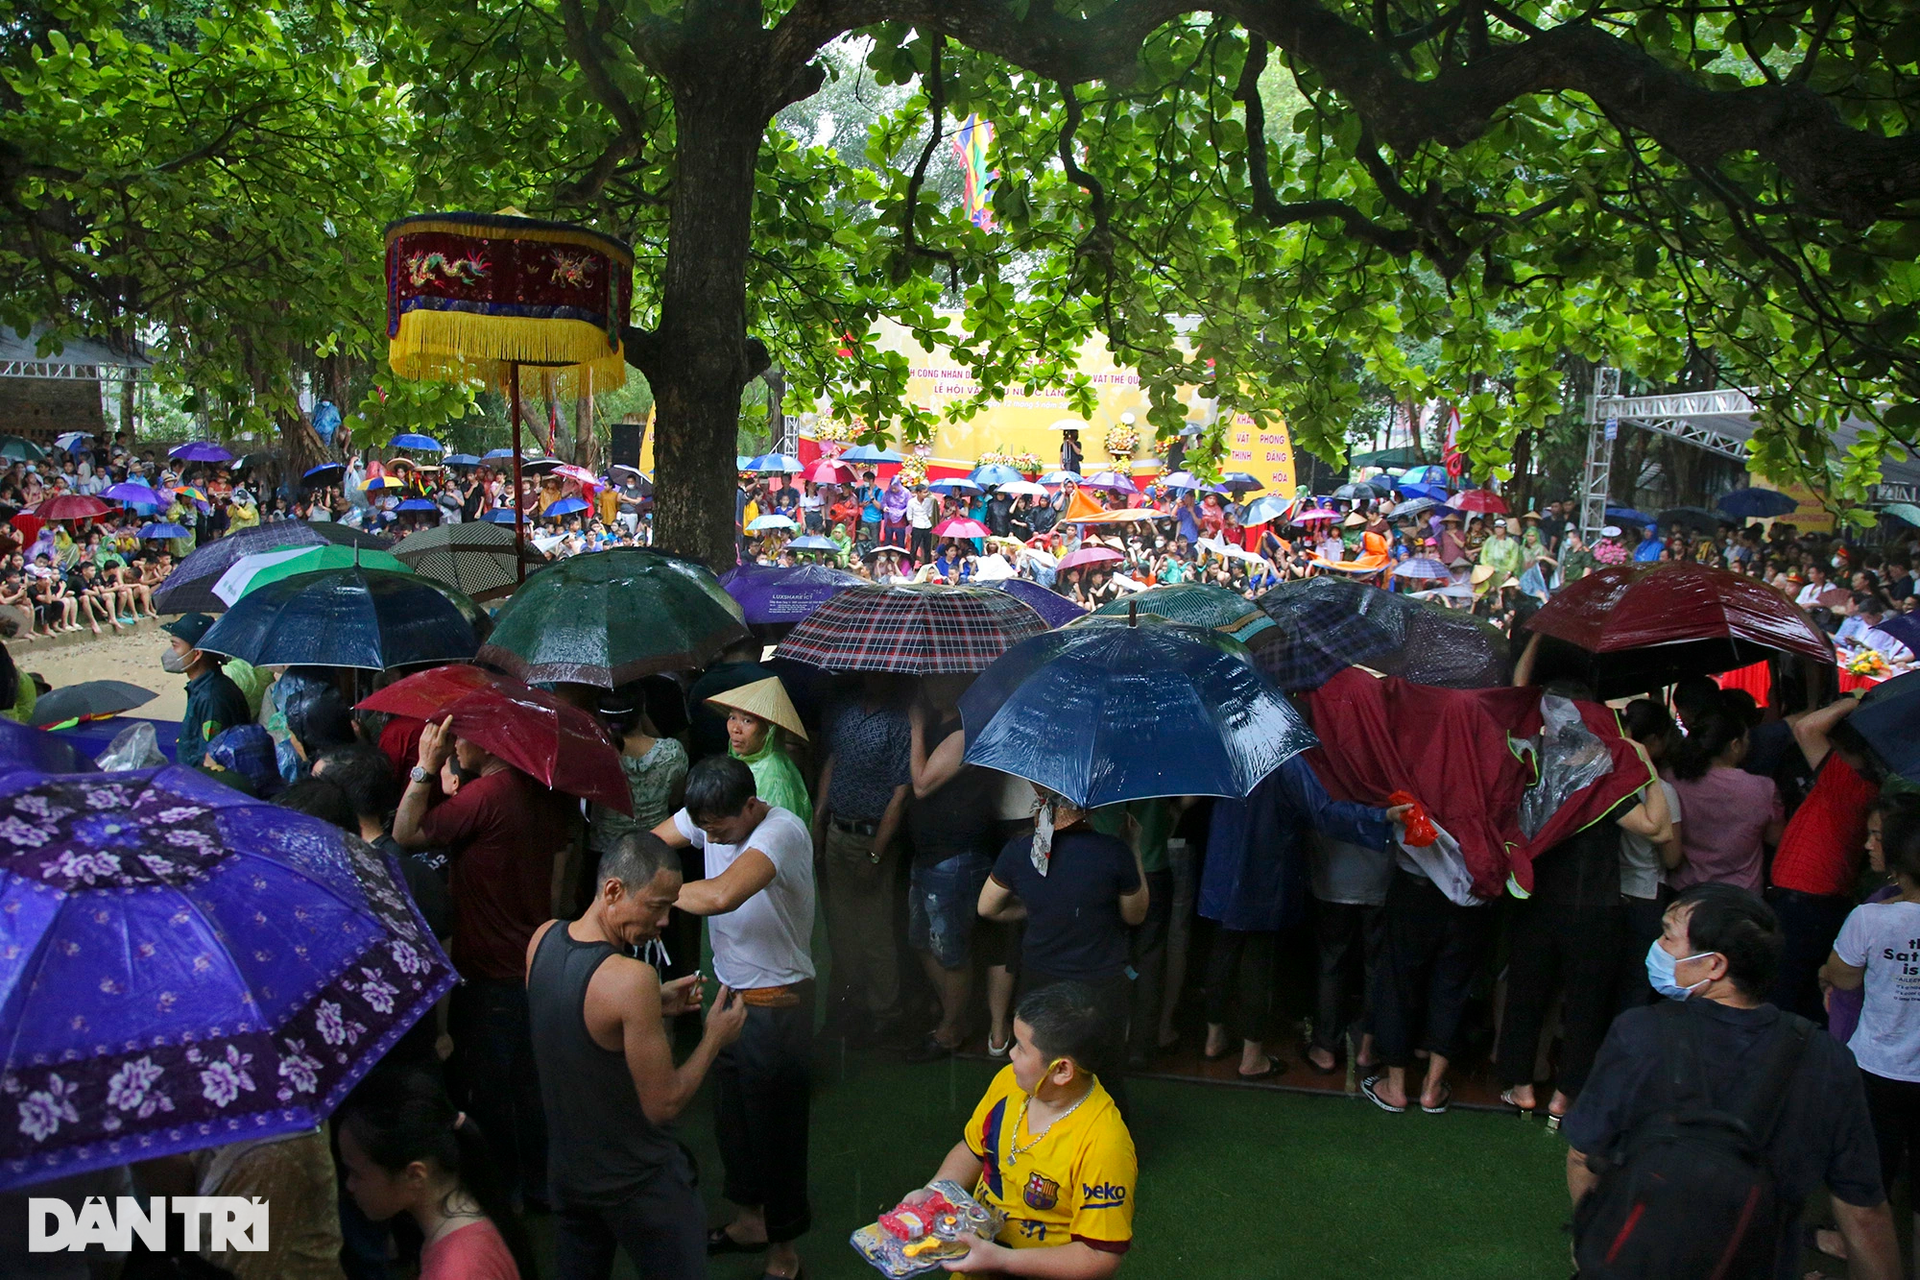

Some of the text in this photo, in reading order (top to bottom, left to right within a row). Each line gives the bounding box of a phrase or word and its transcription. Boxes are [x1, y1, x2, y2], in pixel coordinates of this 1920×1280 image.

[1003, 399, 1012, 408] 12
[1236, 431, 1249, 446] VẬT
[1260, 434, 1285, 445] PHONG
[1232, 450, 1252, 463] THỊNH
[1903, 963, 1919, 975] is
[1082, 1182, 1126, 1200] beko
